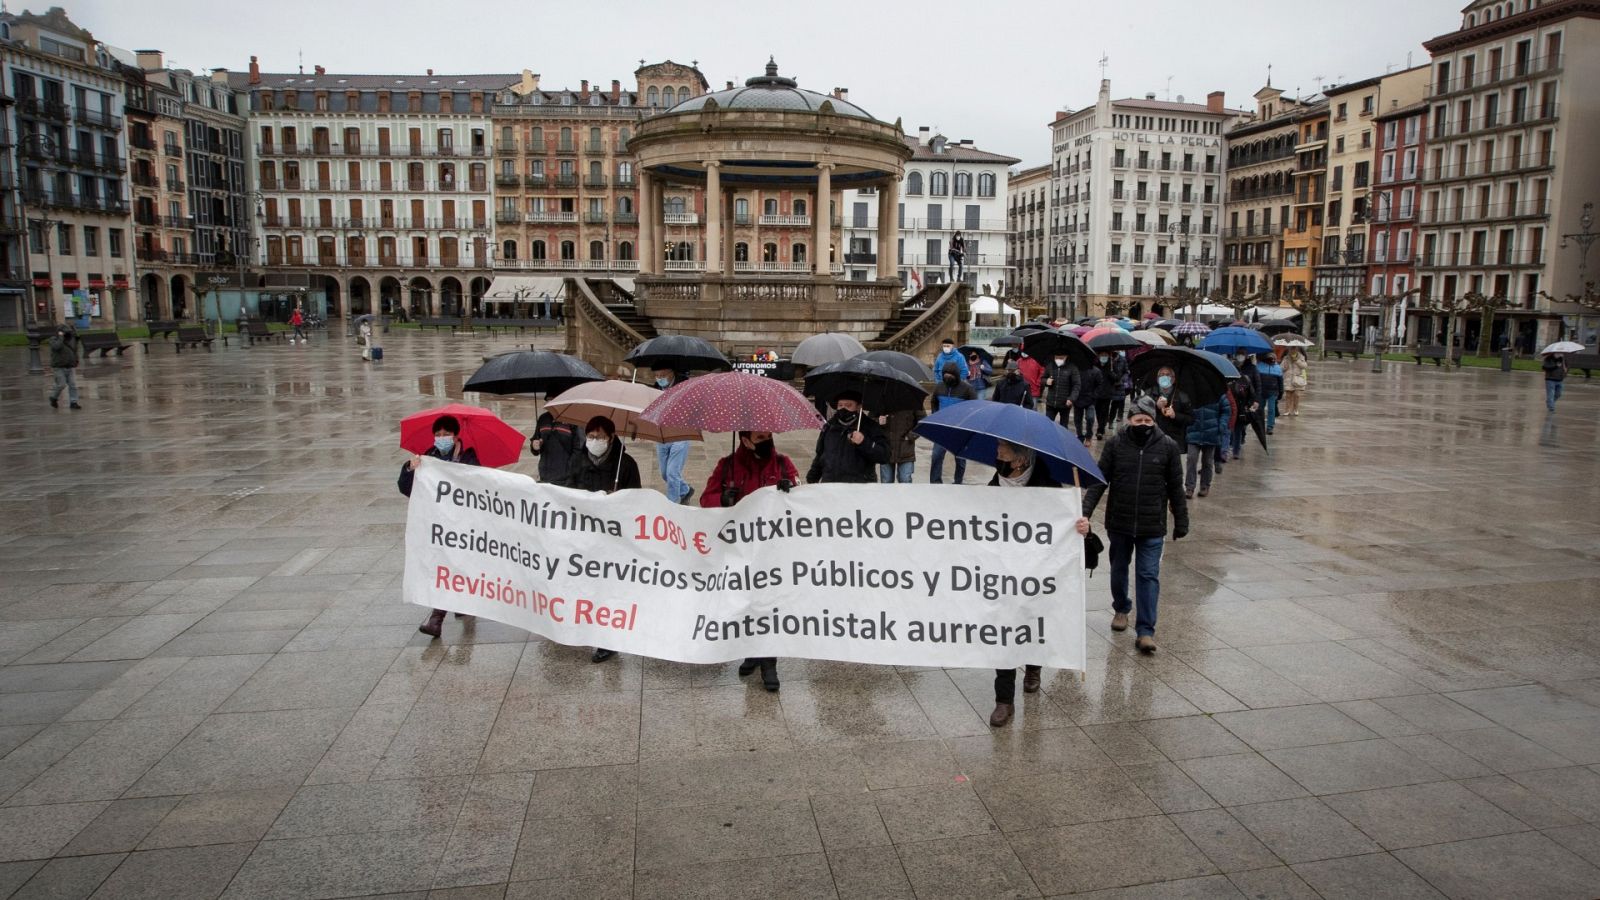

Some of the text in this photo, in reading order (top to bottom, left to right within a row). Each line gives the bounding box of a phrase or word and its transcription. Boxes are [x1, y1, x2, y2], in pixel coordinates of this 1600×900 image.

[1074, 134, 1093, 147] HOTEL
[1112, 131, 1220, 148] HOTEL LA PERLA
[436, 480, 1053, 555] Pensión Mínima 1080 € Gutxieneko Pentsioa
[431, 523, 1057, 601] Residencias y Servicios Sociales Públicos y Dignos
[435, 566, 638, 632] Revisión IPC Real
[692, 607, 1046, 647] Pentsionistak aurrera!
